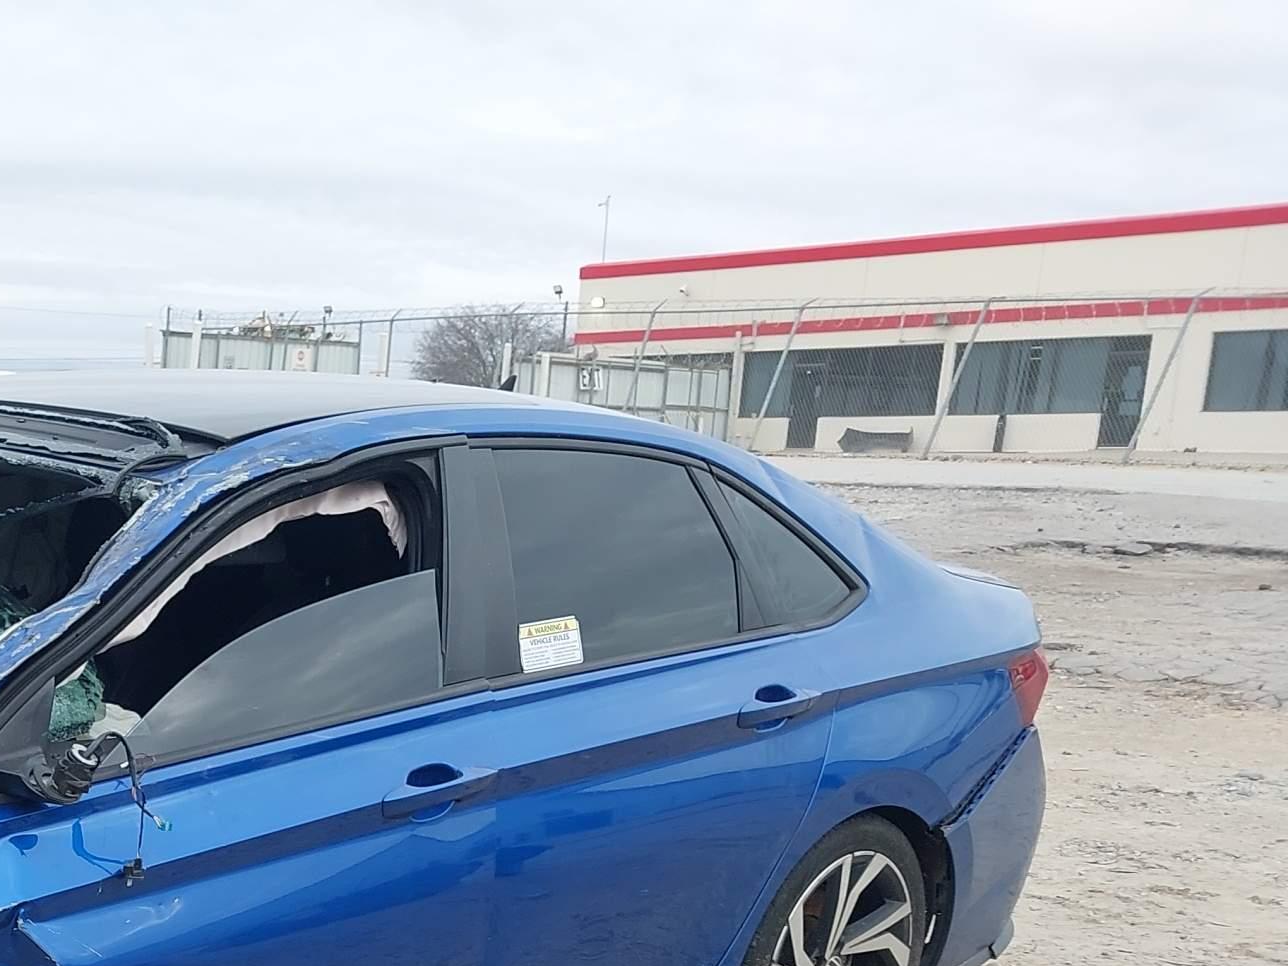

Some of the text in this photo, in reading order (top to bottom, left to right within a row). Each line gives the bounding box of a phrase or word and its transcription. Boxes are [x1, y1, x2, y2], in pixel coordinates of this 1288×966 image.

[581, 367, 601, 388] EXT
[534, 623, 562, 634] WARNING
[529, 633, 570, 646] VEHICLE RULES
